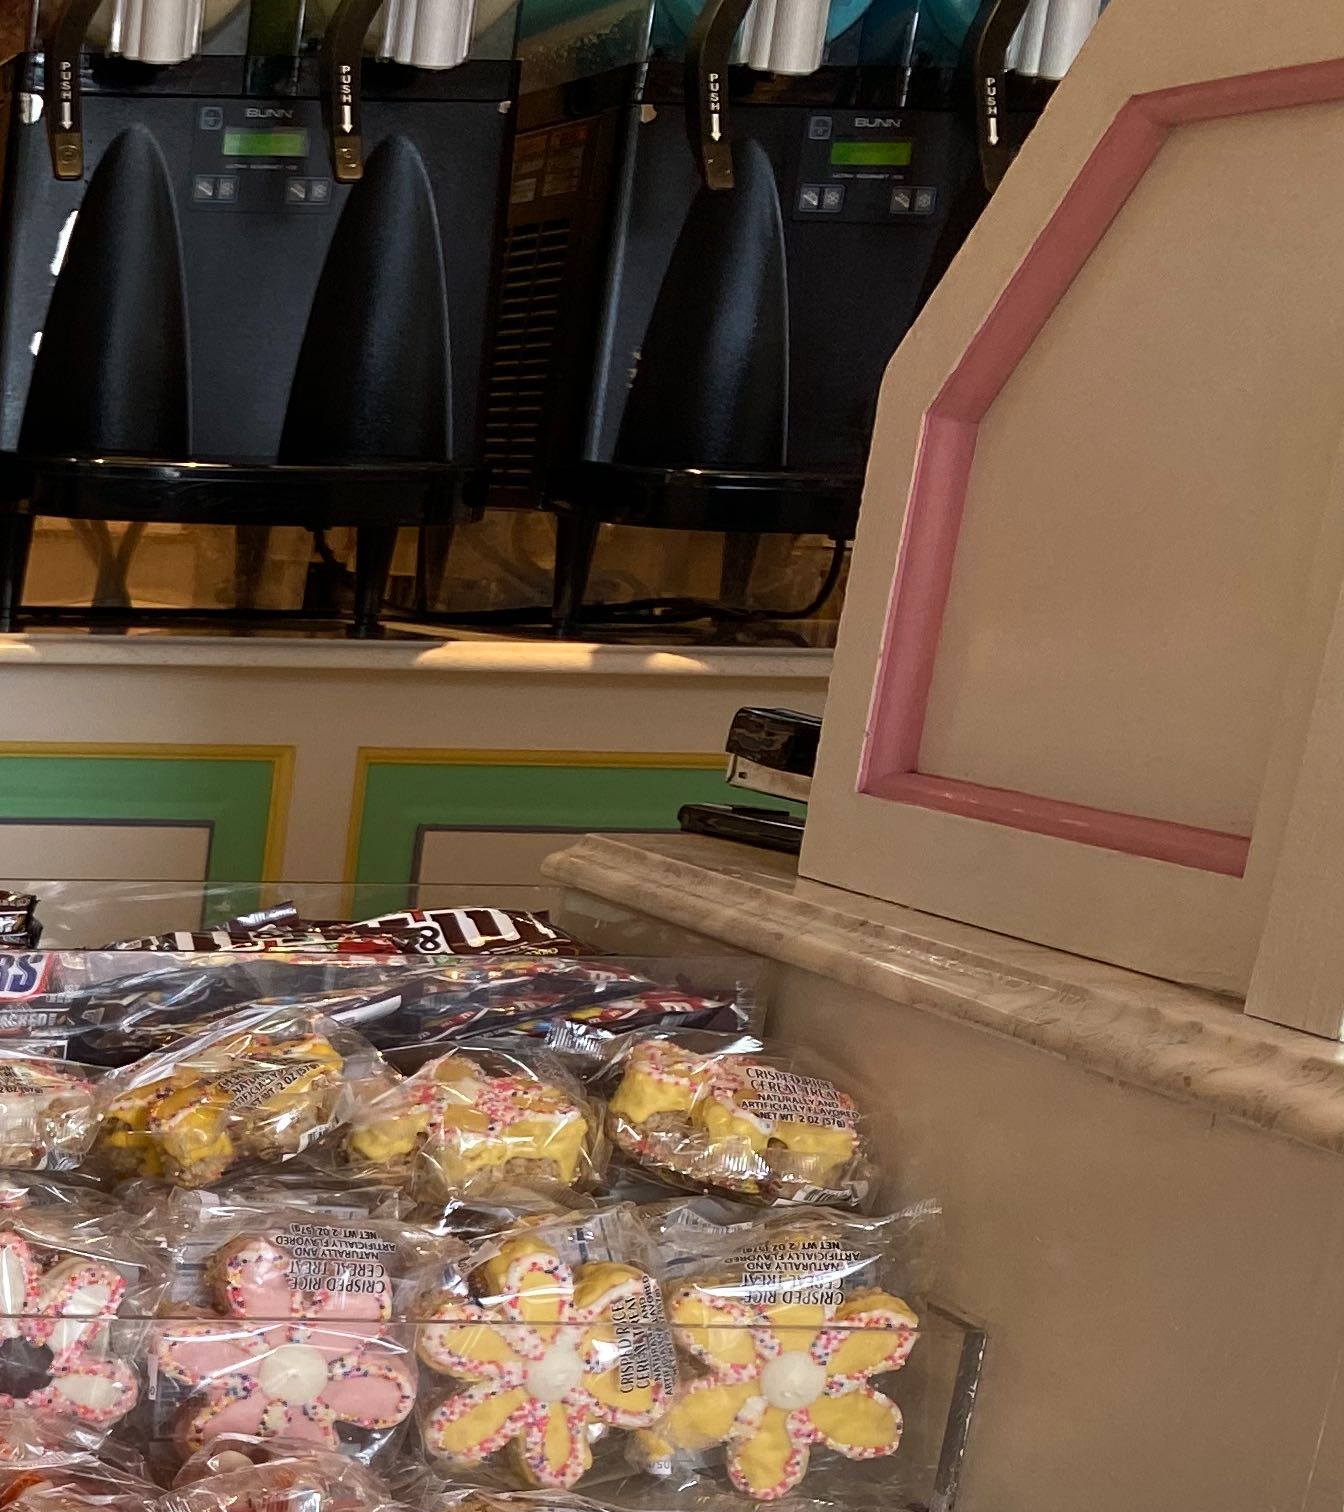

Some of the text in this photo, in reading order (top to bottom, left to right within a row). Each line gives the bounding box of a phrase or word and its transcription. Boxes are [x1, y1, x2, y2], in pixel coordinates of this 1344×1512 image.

[62, 62, 72, 100] PUSH
[340, 66, 351, 103] PUSH
[709, 73, 720, 111] PUSH
[986, 77, 998, 115] PUSH
[245, 108, 293, 118] BUNN
[855, 117, 901, 128] BUNN
[746, 1068, 801, 1084] CRISPED
[751, 1080, 798, 1095] CEREAL
[758, 1094, 839, 1108] NATURALLY AND
[742, 1101, 860, 1119] ARTIFICIALLY FLAVORED
[760, 1112, 820, 1124] NET 2 OZ
[361, 1231, 377, 1239] NET
[276, 1236, 396, 1251] ARTIFICIALLY FLAVORED
[820, 1242, 840, 1250] NET
[295, 1247, 379, 1260] NATURALLY AND
[787, 1252, 861, 1261] ARTIFICIALLY
[290, 1260, 385, 1277] CEREAL TREAT
[747, 1262, 840, 1271] NATURALLY AND
[290, 1277, 385, 1293] CRISPED RICE
[744, 1290, 844, 1305] CRISPED RICE
